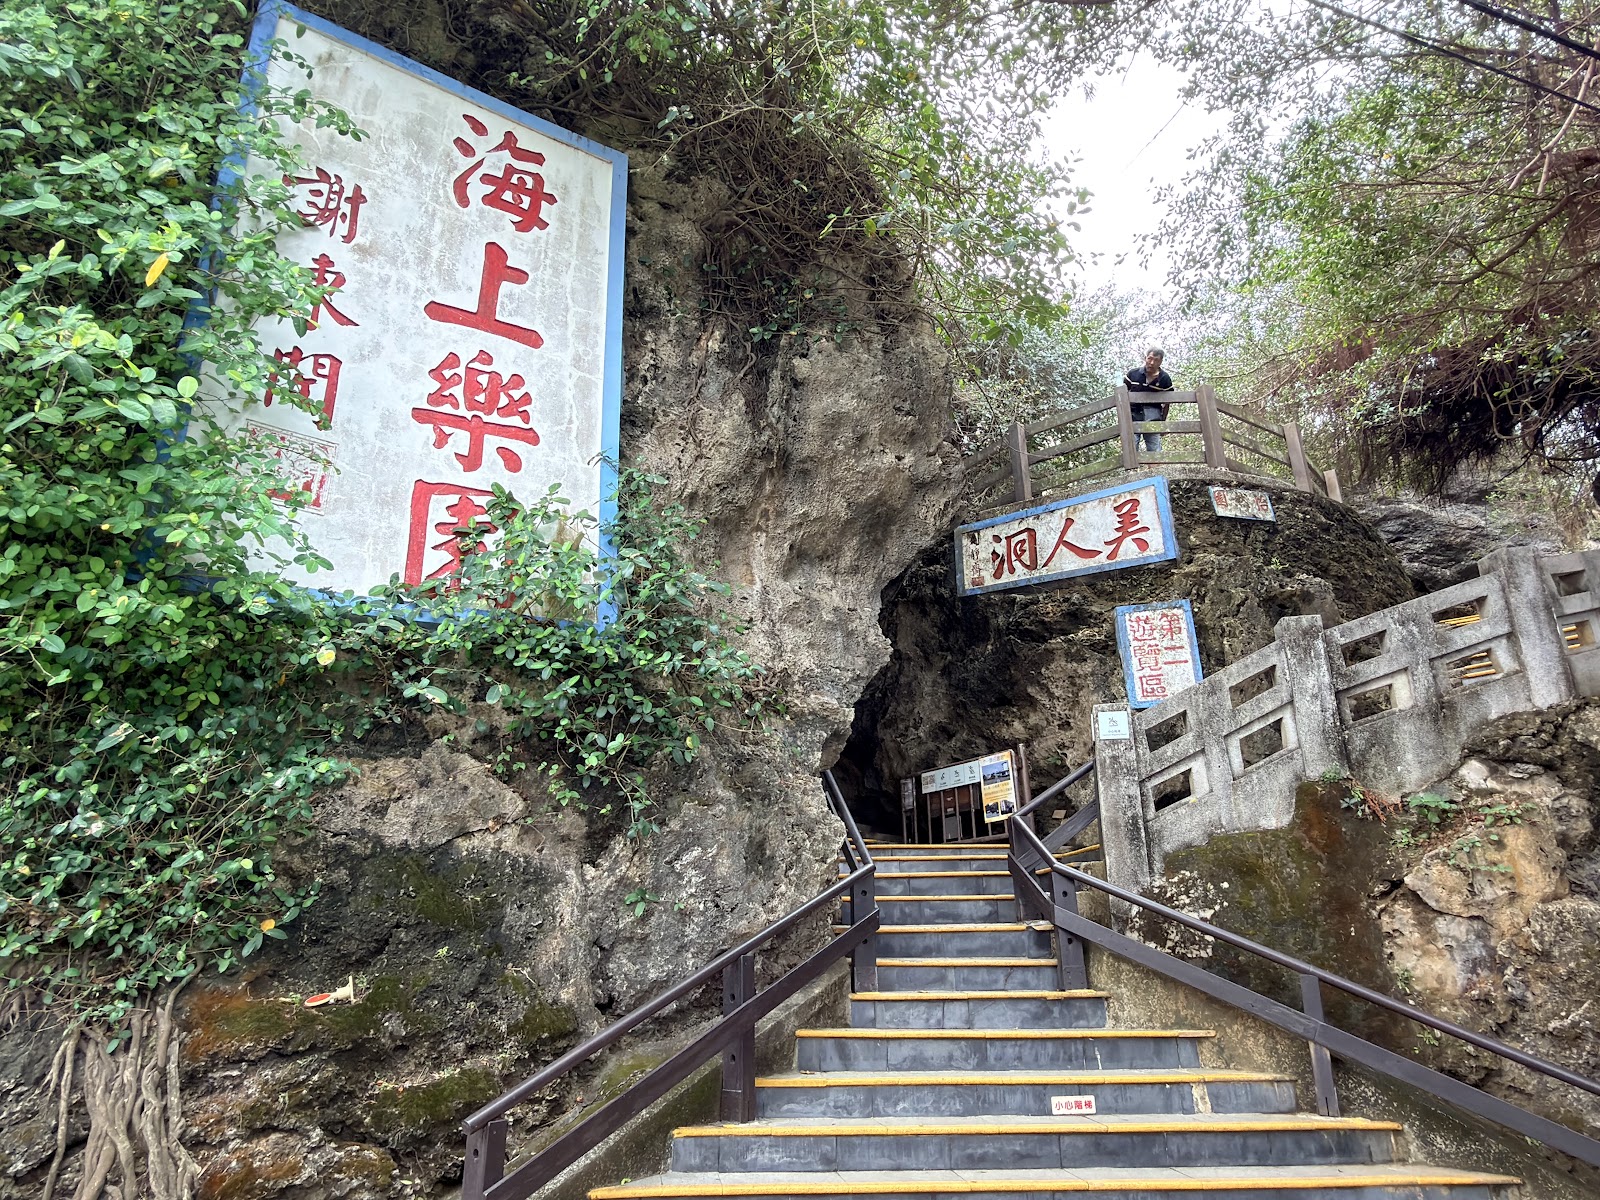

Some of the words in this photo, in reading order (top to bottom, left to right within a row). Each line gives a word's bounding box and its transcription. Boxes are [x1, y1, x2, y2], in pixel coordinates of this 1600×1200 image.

[992, 498, 1151, 580] 美人洞
[1129, 615, 1169, 698] 遊覽區
[1159, 612, 1188, 665] 第二
[1055, 1100, 1093, 1110] 小心階梯
